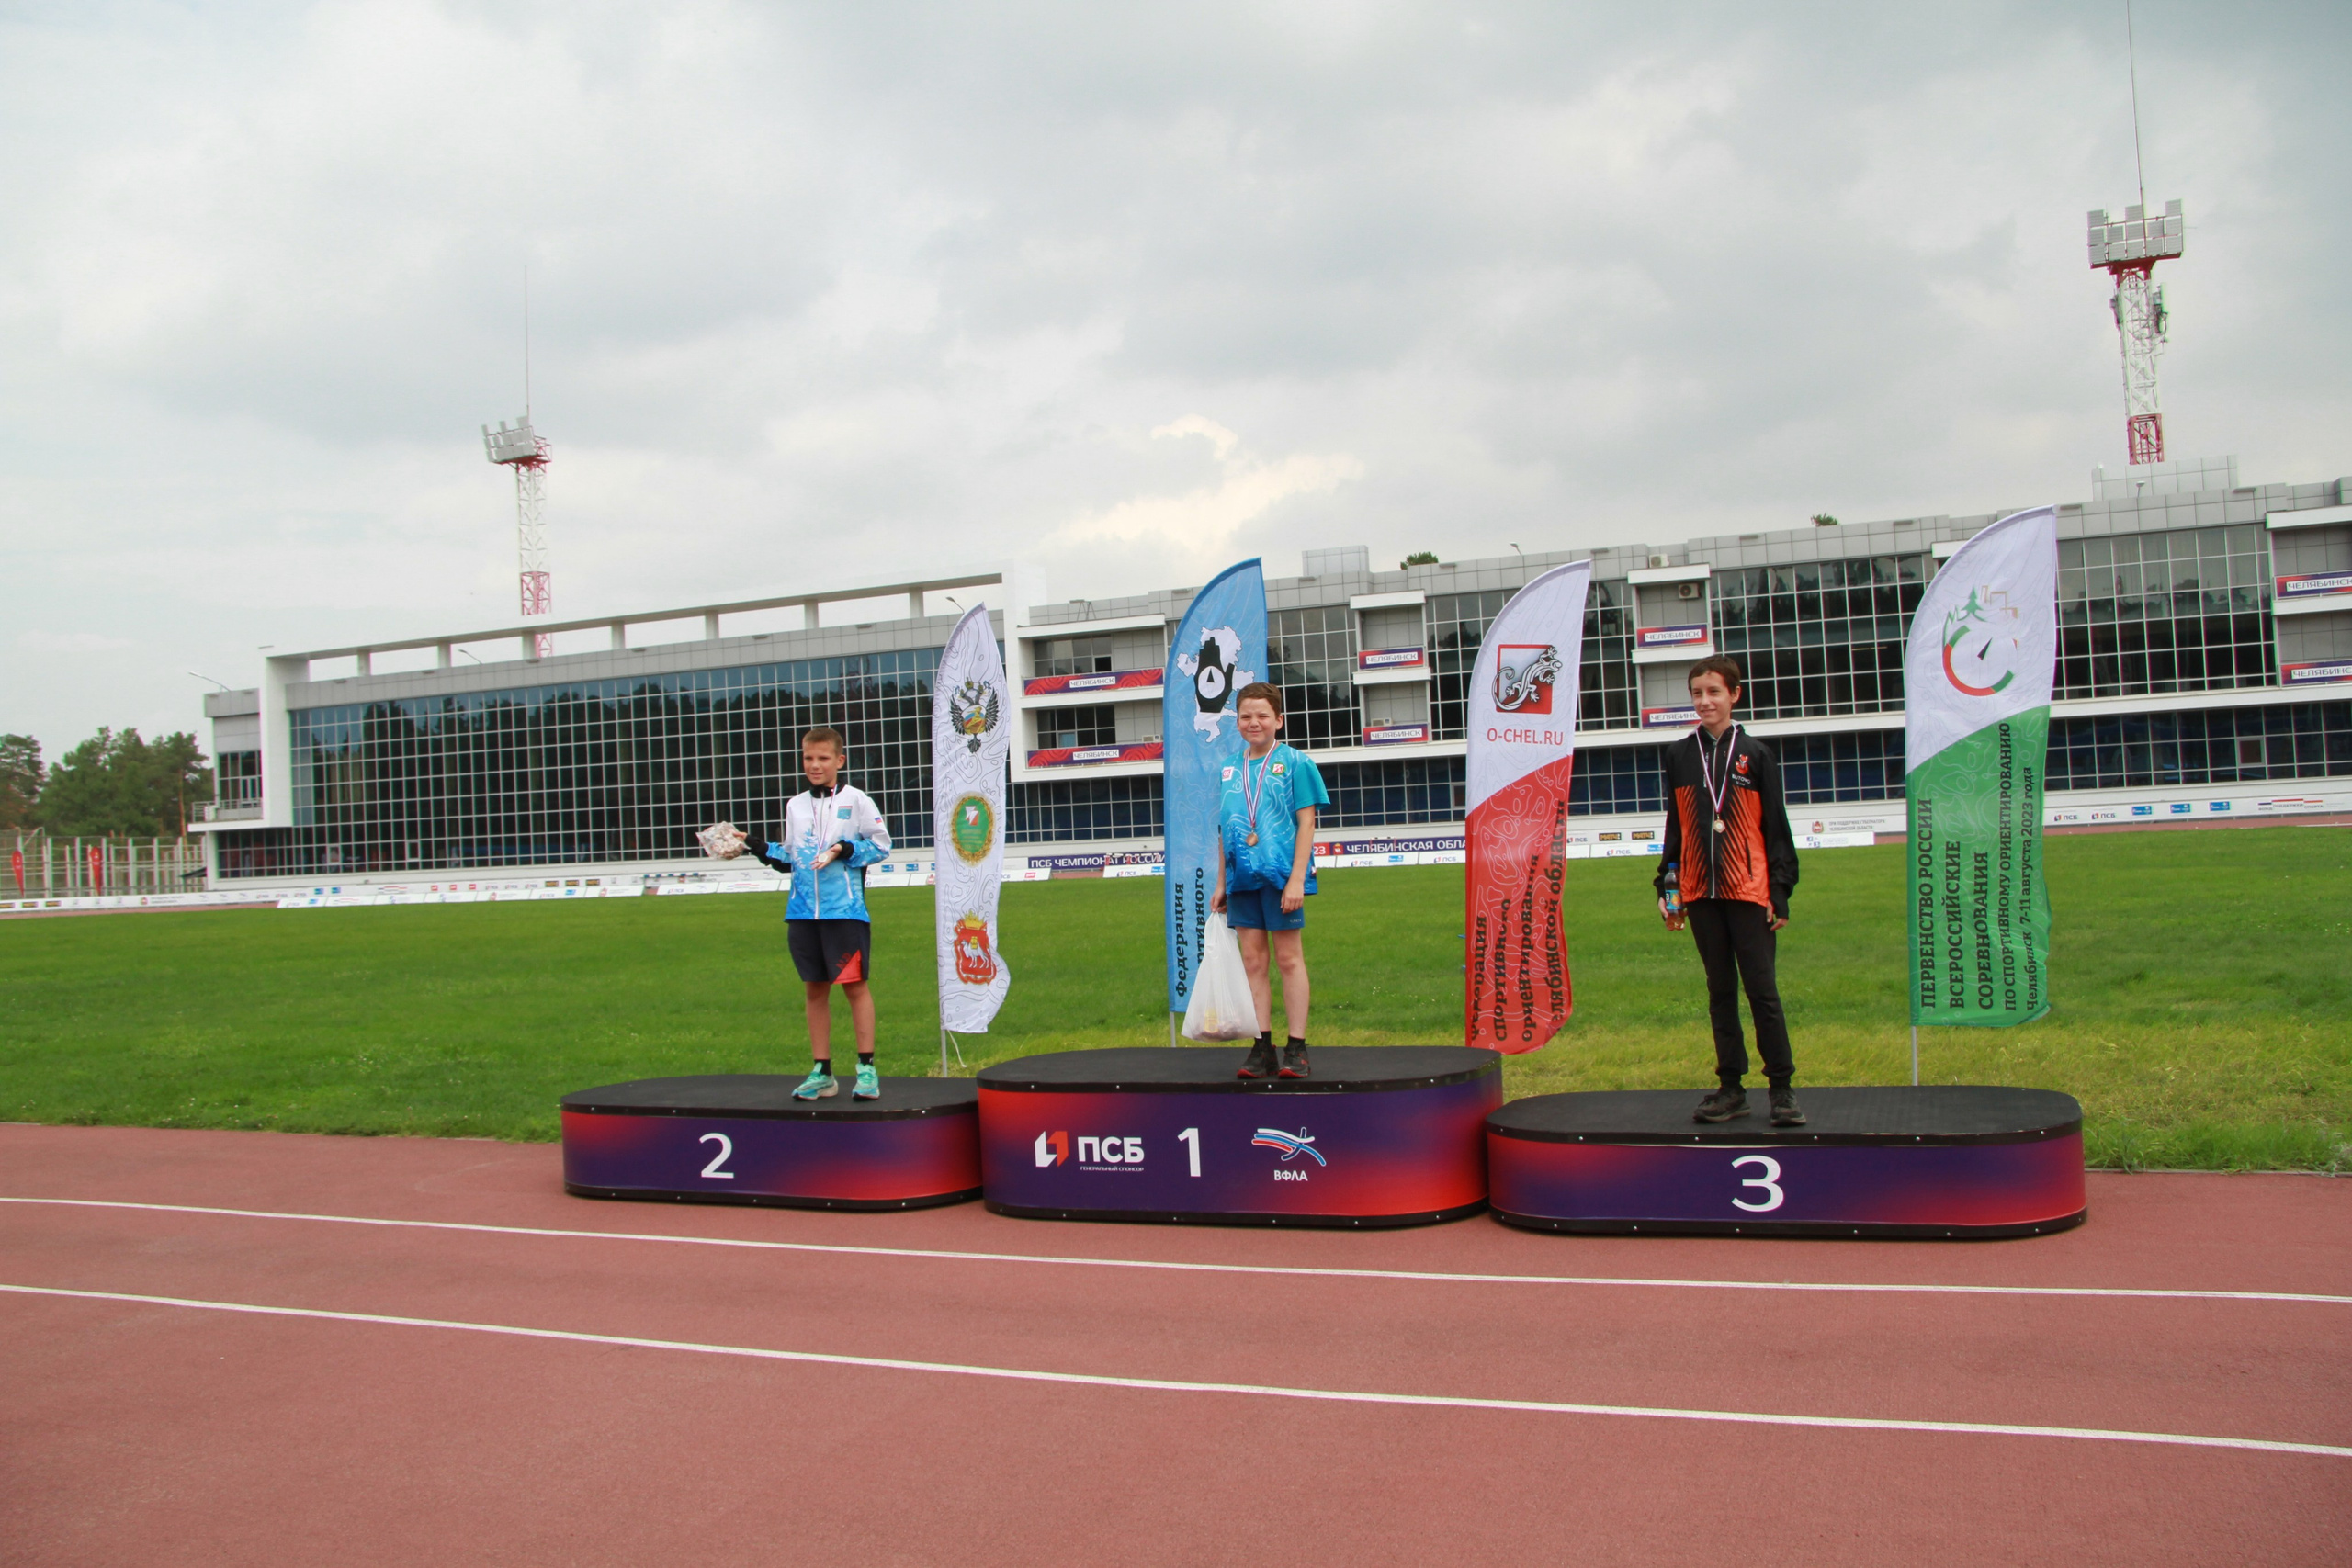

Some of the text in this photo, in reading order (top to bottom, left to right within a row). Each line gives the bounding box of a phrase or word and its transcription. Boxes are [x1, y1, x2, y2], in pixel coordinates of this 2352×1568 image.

[1646, 630, 1700, 640] ЧЕЛЯБИНСК
[1367, 653, 1417, 663] ЧЕЛЯБИНСК
[2293, 667, 2352, 677] ЧЕЛЯБИНС
[1070, 677, 1114, 687] ЧЕЛЯБИНСК
[1650, 712, 1698, 721] ЧЕЛЯБИНС
[1371, 729, 1421, 739] ЧЕЛЯБИНСК
[1487, 728, 1564, 746] O-CHEL.RU
[1073, 750, 1118, 759] ЧЕЛЯБИНСК
[1314, 845, 1327, 855] 23
[1346, 840, 1466, 853] ЧЕЛЯБИНСКАЯ ОБЛА
[1031, 859, 1053, 868] ПСБ
[1054, 855, 1119, 867] ЧЕМПИОНАТ
[1997, 722, 2017, 1010] ПО СПОРТИВНОМУ ОРИЕНТИРОВАНИЮ
[2019, 766, 2039, 1010] Челябинск 7-11 августа 2023 года
[1917, 798, 1936, 1008] ПЕРВЕНСТВО РОССИИ
[1195, 867, 1205, 964] ртивного
[1940, 841, 1964, 1009] ВСЕРОССИЙСКИЕ
[1973, 852, 1994, 1010] СОРЕВНОВАНИЯ
[1175, 883, 1188, 997] Федерация
[699, 1133, 734, 1179] 2
[1077, 1136, 1145, 1164] ПСБ
[1177, 1128, 1201, 1177] 1
[1273, 1169, 1308, 1182] ВФЛА
[1731, 1155, 1784, 1212] 3
